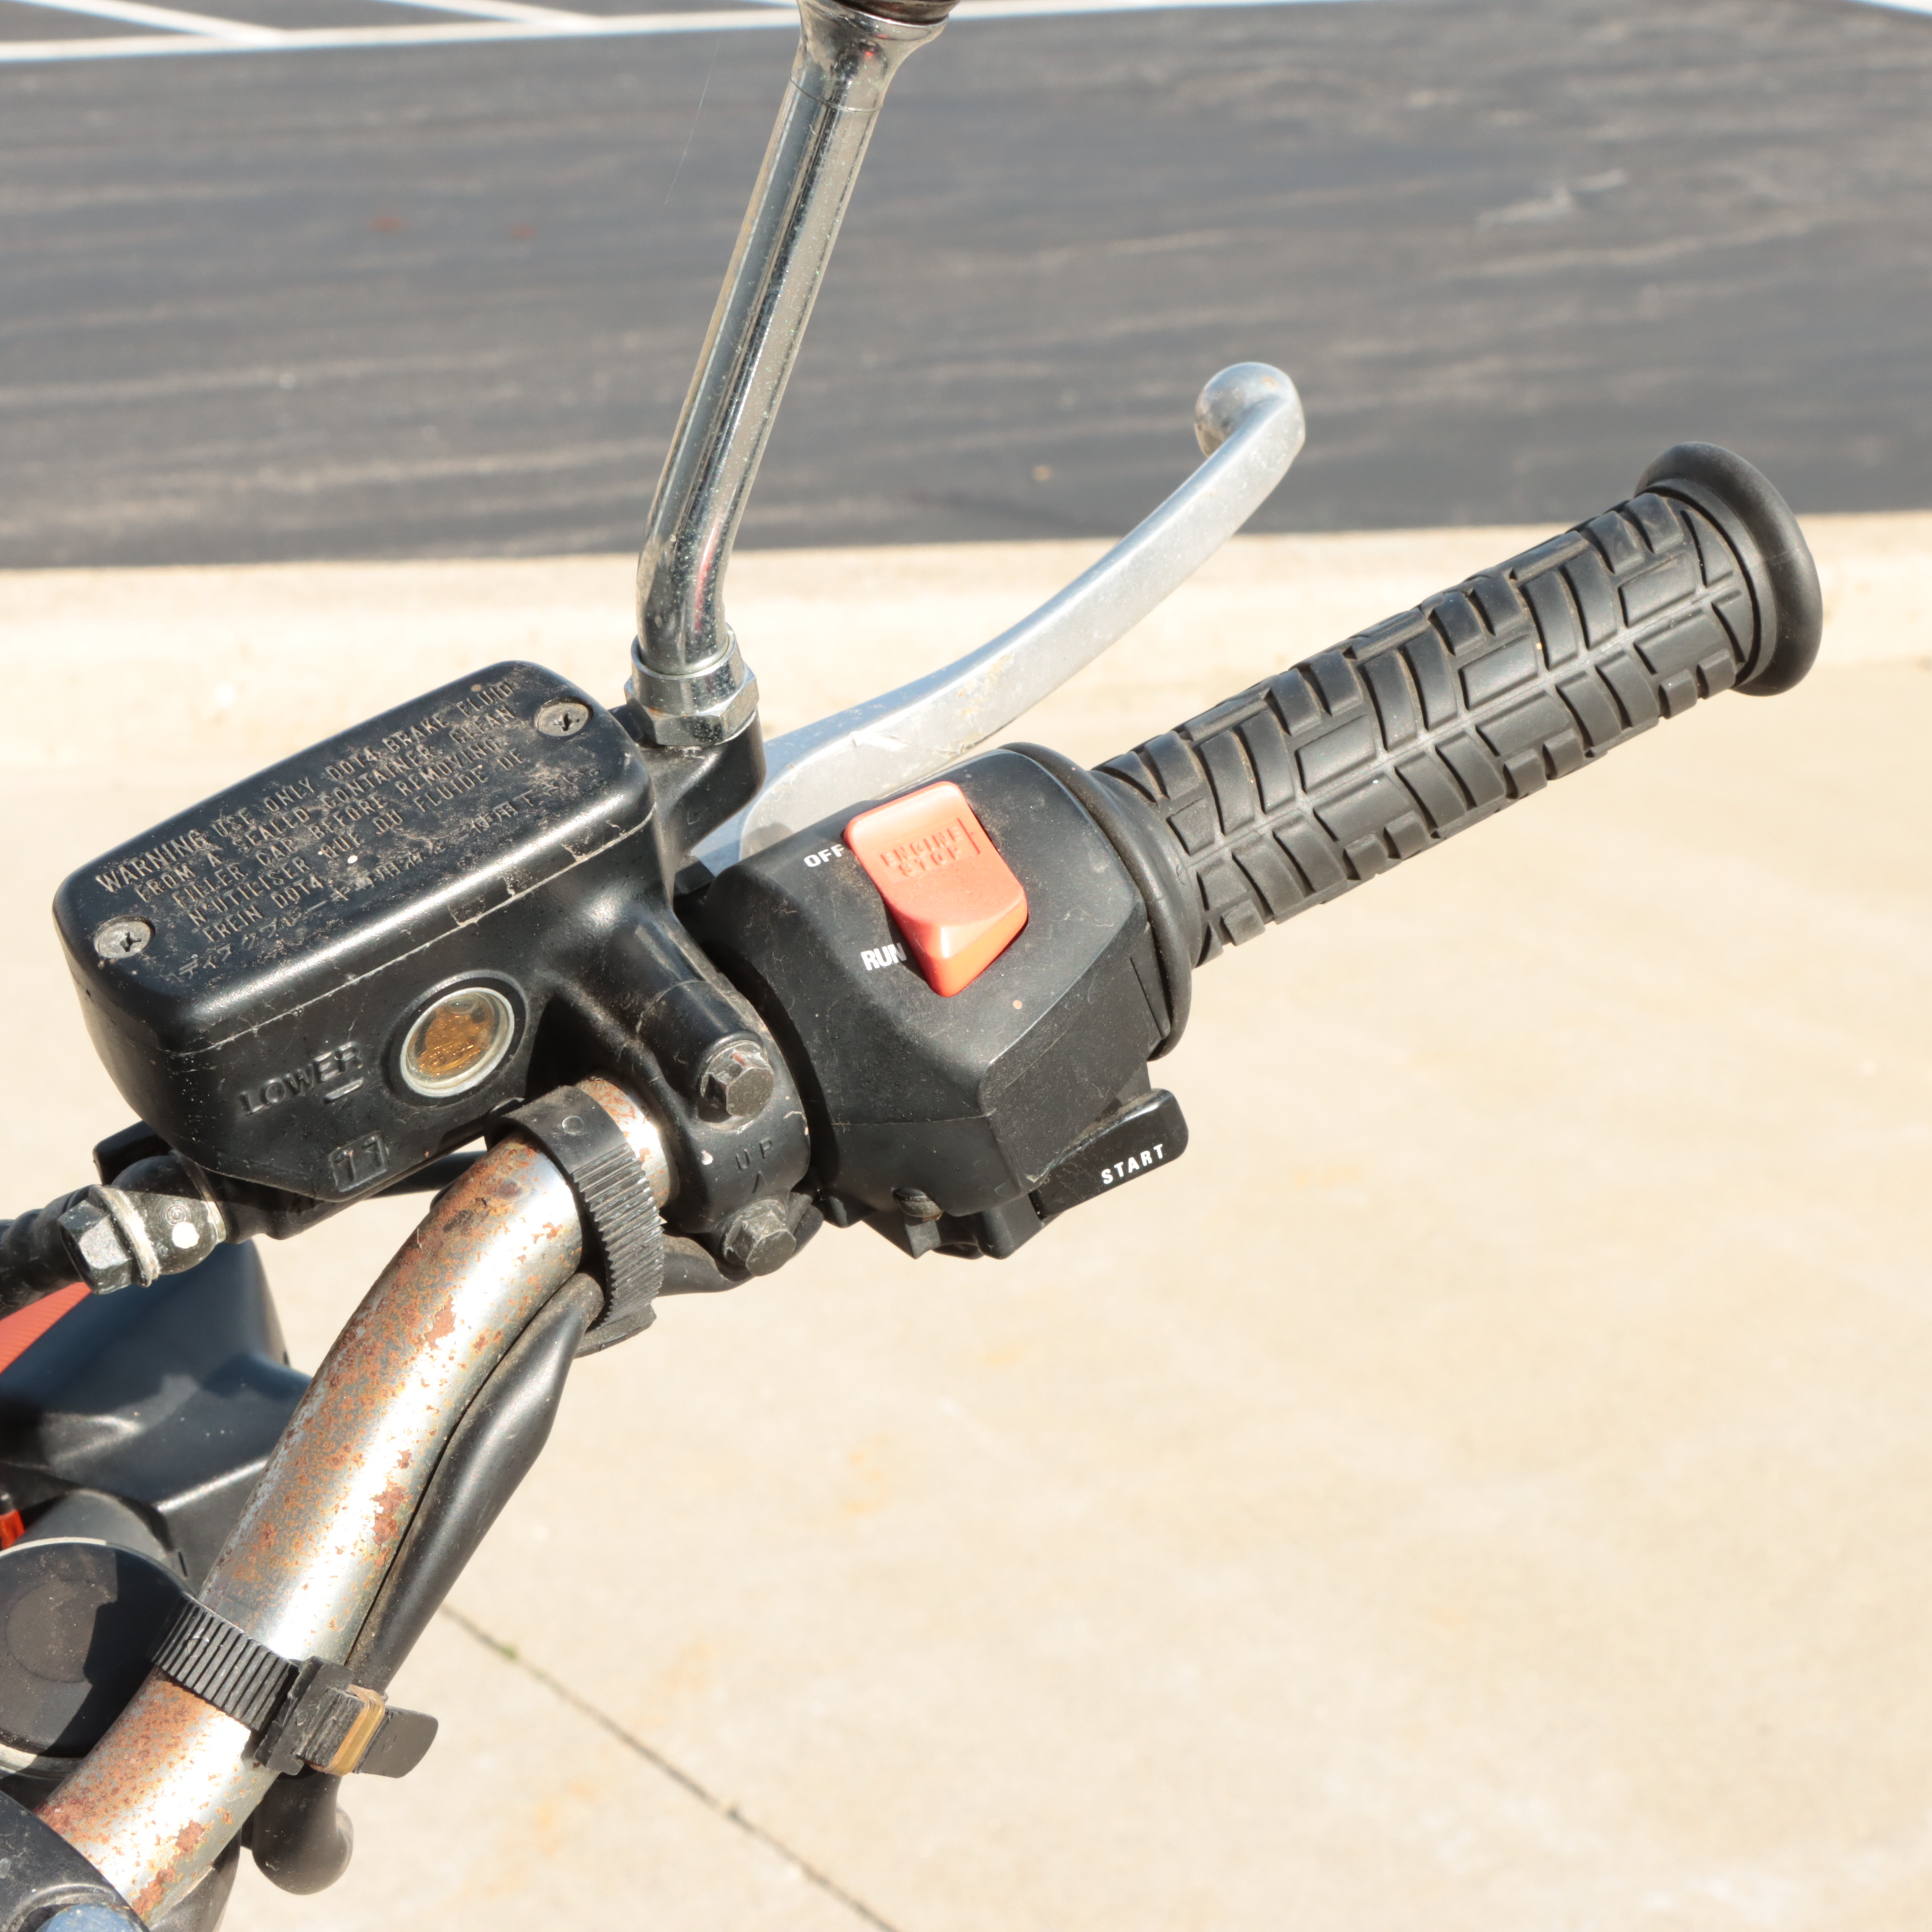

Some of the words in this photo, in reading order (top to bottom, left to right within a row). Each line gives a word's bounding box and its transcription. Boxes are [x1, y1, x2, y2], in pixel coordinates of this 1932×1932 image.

[95, 829, 206, 894] WARNING
[211, 807, 252, 837] USE
[263, 777, 315, 813] ONLY
[325, 746, 379, 781] DOT4
[382, 712, 449, 753] BRAKE
[456, 680, 514, 717] FLUID
[135, 865, 196, 903] FROM
[207, 852, 223, 868] A
[232, 806, 310, 853] SEALED
[449, 705, 515, 744] CLEAN
[320, 831, 364, 859] QUE
[373, 810, 405, 834] DU
[414, 764, 488, 812] FLUIDE
[497, 748, 523, 771] DE
[171, 863, 245, 907] FILLER
[256, 837, 298, 866] CAP
[308, 795, 388, 840] BEFORE
[804, 844, 845, 867] OFF
[879, 825, 964, 868] ENGINE
[898, 846, 962, 877] STOP
[202, 905, 264, 942] FREIN
[270, 875, 324, 909] DOT4
[860, 942, 907, 971] RUN
[240, 1040, 362, 1115] LOWER
[735, 1137, 773, 1171] UP
[1101, 1144, 1163, 1185] START
